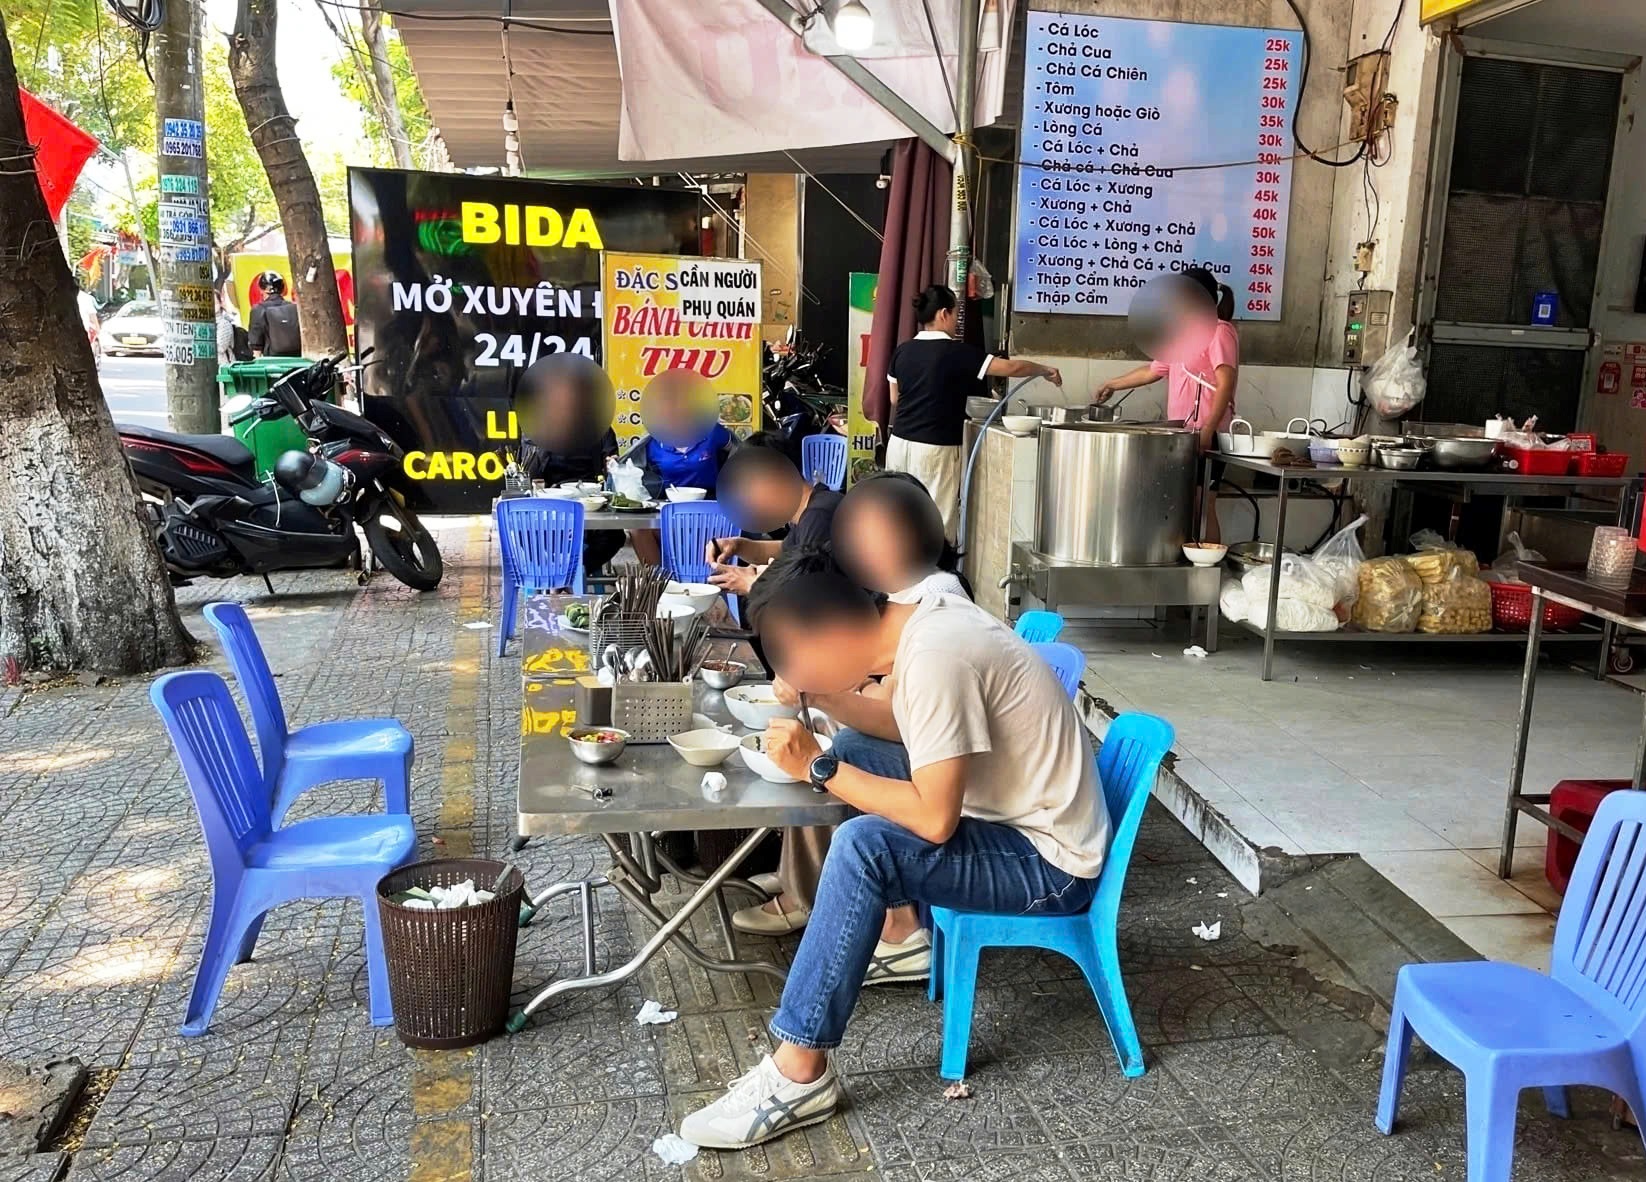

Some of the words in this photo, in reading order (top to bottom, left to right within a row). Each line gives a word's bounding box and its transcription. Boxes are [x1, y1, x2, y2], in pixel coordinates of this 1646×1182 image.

[1048, 23, 1068, 35] Cá
[1075, 25, 1098, 38] Lóc
[1048, 42, 1076, 56] Chả
[1082, 45, 1111, 58] Cua
[1266, 39, 1290, 52] 25k
[1047, 62, 1075, 75] Chả
[1081, 65, 1101, 77] Cá
[1107, 67, 1147, 80] Chiên
[1264, 58, 1288, 72] 25k
[1045, 82, 1074, 95] Tôm
[1263, 77, 1286, 91] 25k
[1044, 101, 1090, 119] Xương
[1096, 105, 1131, 121] hoặc
[1136, 108, 1159, 120] Giò
[1261, 96, 1285, 110] 30k
[1044, 120, 1076, 137] Lòng
[1082, 123, 1102, 135] Cá
[1260, 115, 1283, 129] 35k
[1043, 140, 1062, 152] Cá
[1069, 142, 1092, 154] Lóc
[1110, 143, 1138, 156] Chả
[1258, 134, 1282, 148] 30k
[1257, 153, 1280, 166] 30k
[1041, 159, 1071, 172] Chả
[1075, 161, 1093, 173] cá
[1111, 162, 1140, 176] Chả
[1145, 165, 1173, 178] Cua
[1256, 172, 1280, 184] 30k
[1041, 178, 1061, 190] Cá
[1067, 180, 1090, 192] Lóc
[1108, 182, 1152, 199] Xương
[1255, 190, 1278, 202] 45k
[1040, 198, 1085, 214] Xương
[1103, 200, 1131, 213] Chả
[1253, 209, 1276, 221] 40k
[461, 202, 604, 250] BIDA
[1039, 216, 1059, 228] Cá
[1065, 217, 1088, 229] Lóc
[1106, 220, 1150, 236] Xương
[1168, 222, 1195, 235] Chả
[1252, 227, 1275, 240] 50k
[1039, 235, 1058, 247] Cá
[1064, 236, 1087, 248] Lóc
[1105, 238, 1137, 254] Lòng
[1155, 240, 1182, 253] Chả
[1251, 246, 1274, 258] 35k
[1038, 254, 1083, 270] Xương
[1101, 256, 1128, 268] Chả
[1134, 258, 1153, 270] Cá
[1202, 261, 1231, 274] Cua
[1249, 264, 1273, 276] 45k
[616, 267, 659, 294] ĐẶC
[680, 264, 709, 287] CẦN
[714, 268, 757, 289] NGƯỜI
[1037, 273, 1070, 290] Thập
[1076, 274, 1108, 286] Cẩm
[392, 274, 453, 313] MỞ
[462, 281, 582, 318] XUYÊN
[1248, 282, 1272, 295] 45k
[1037, 292, 1070, 309] Thập
[1075, 289, 1107, 304] Cẩm
[1247, 300, 1271, 313] 65k
[683, 300, 712, 319] PHỤ
[717, 297, 755, 319] QUÁN
[613, 298, 681, 337] BÁNH
[641, 347, 731, 378] THU
[403, 451, 505, 480] CARO
